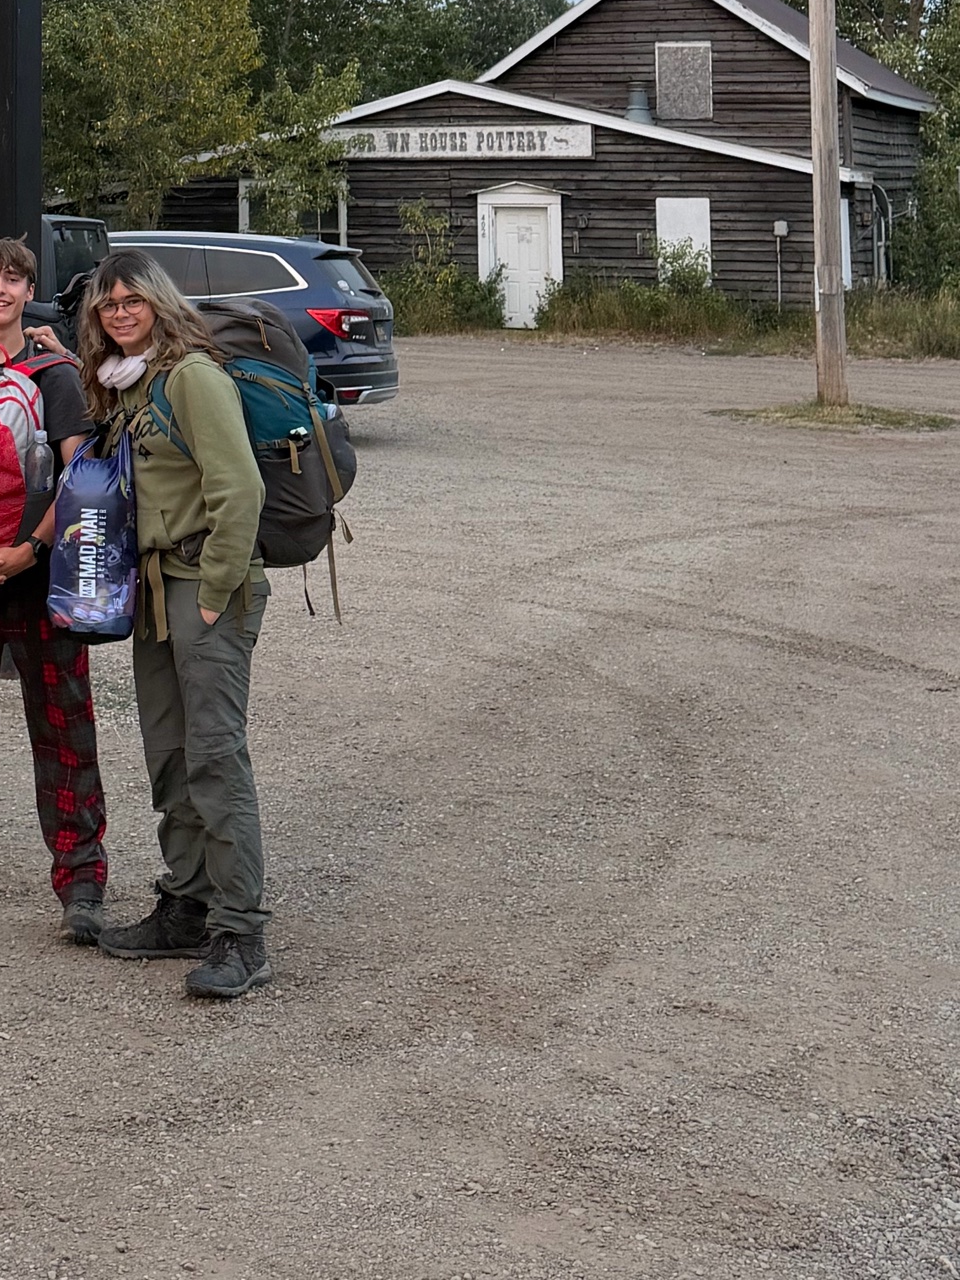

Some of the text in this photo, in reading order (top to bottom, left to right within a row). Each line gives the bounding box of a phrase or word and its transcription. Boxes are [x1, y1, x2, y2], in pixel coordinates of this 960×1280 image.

[419, 132, 467, 152] HOUSE
[476, 131, 547, 153] POTTERY
[80, 508, 98, 542] MAN
[97, 508, 107, 579] BEACHCOMBER
[79, 545, 97, 578] MAD
